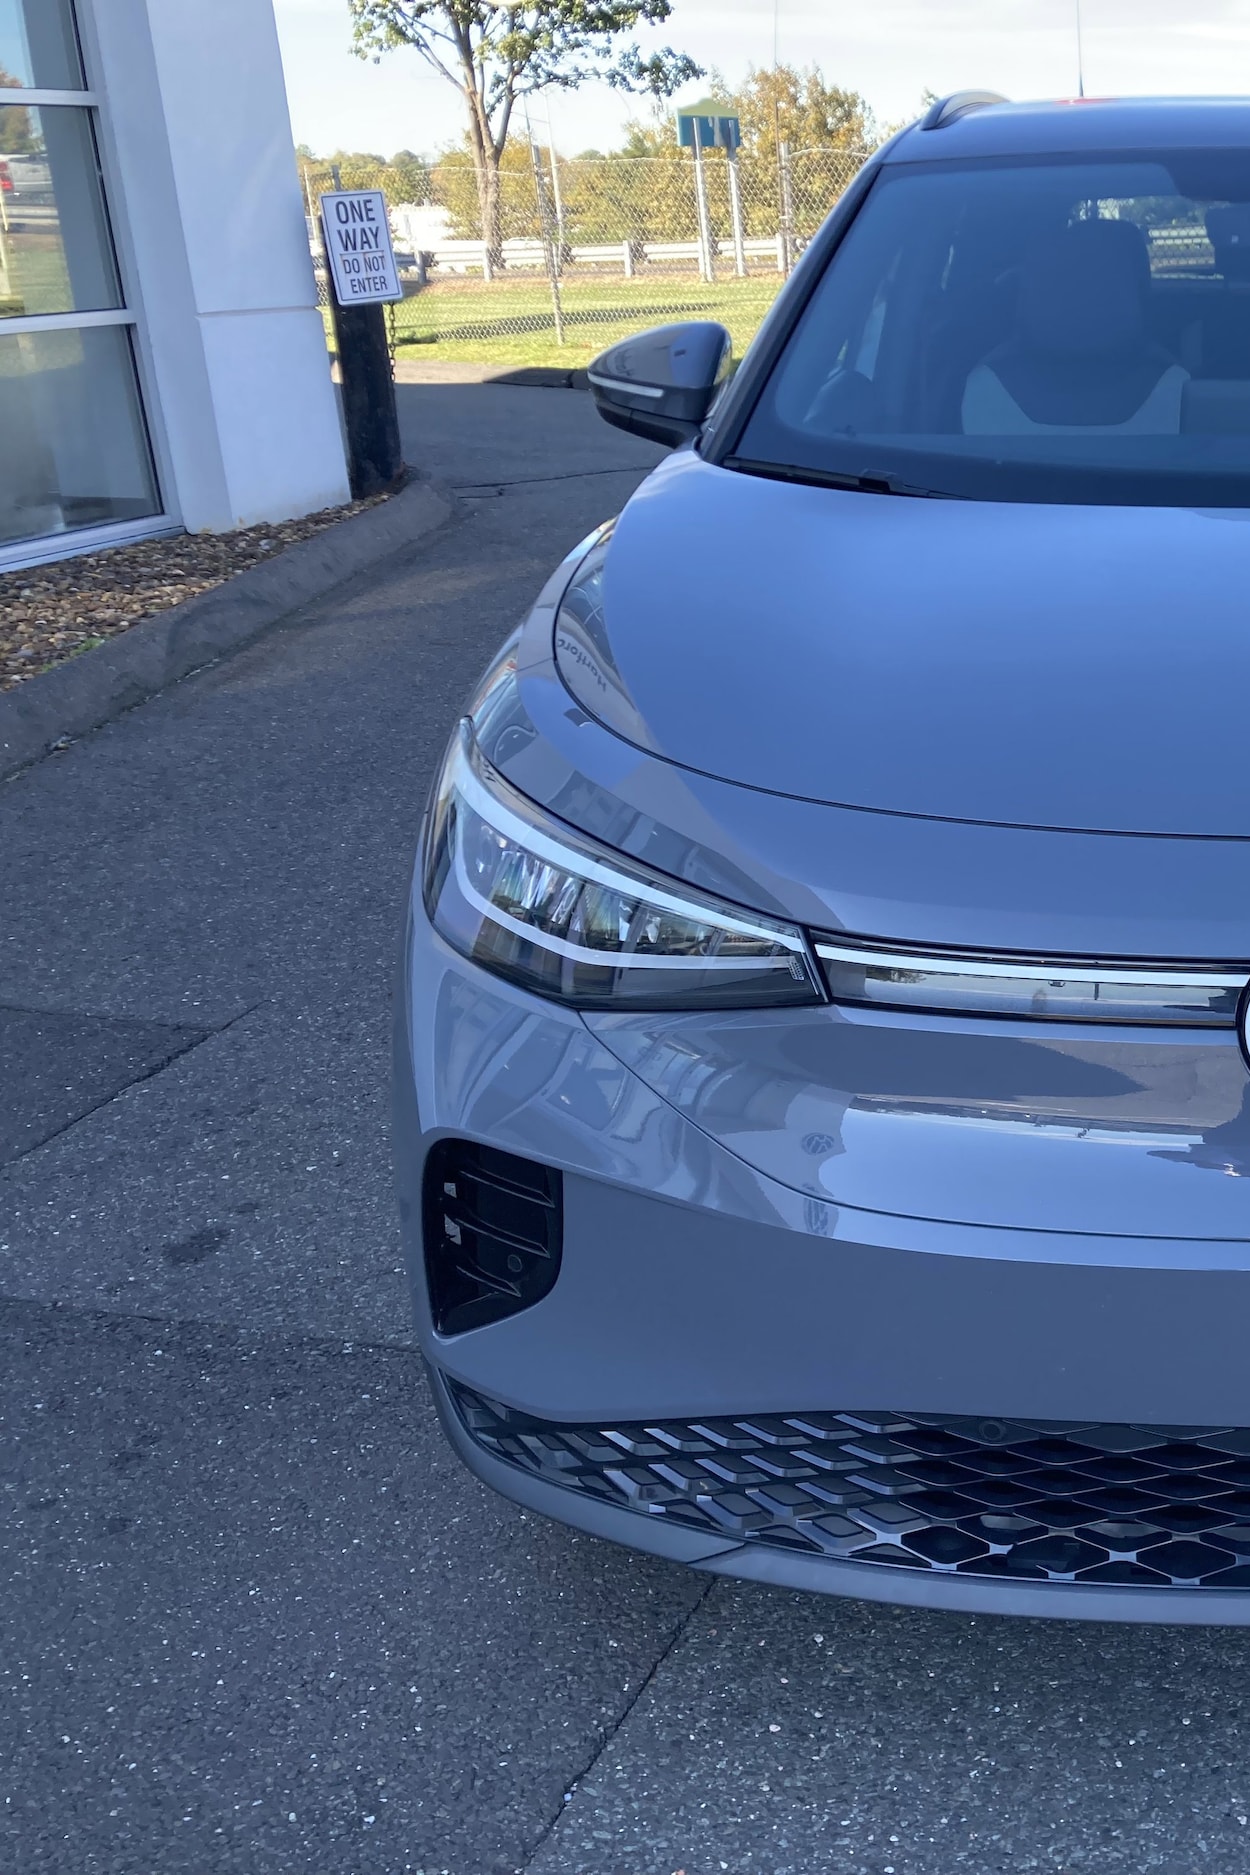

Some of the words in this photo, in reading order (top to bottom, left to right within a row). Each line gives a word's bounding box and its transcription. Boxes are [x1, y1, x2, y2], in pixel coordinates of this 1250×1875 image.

[335, 199, 375, 225] ONE
[337, 226, 379, 252] WAY
[342, 258, 360, 274] DO
[363, 255, 385, 273] NOT
[350, 275, 388, 294] ENTER
